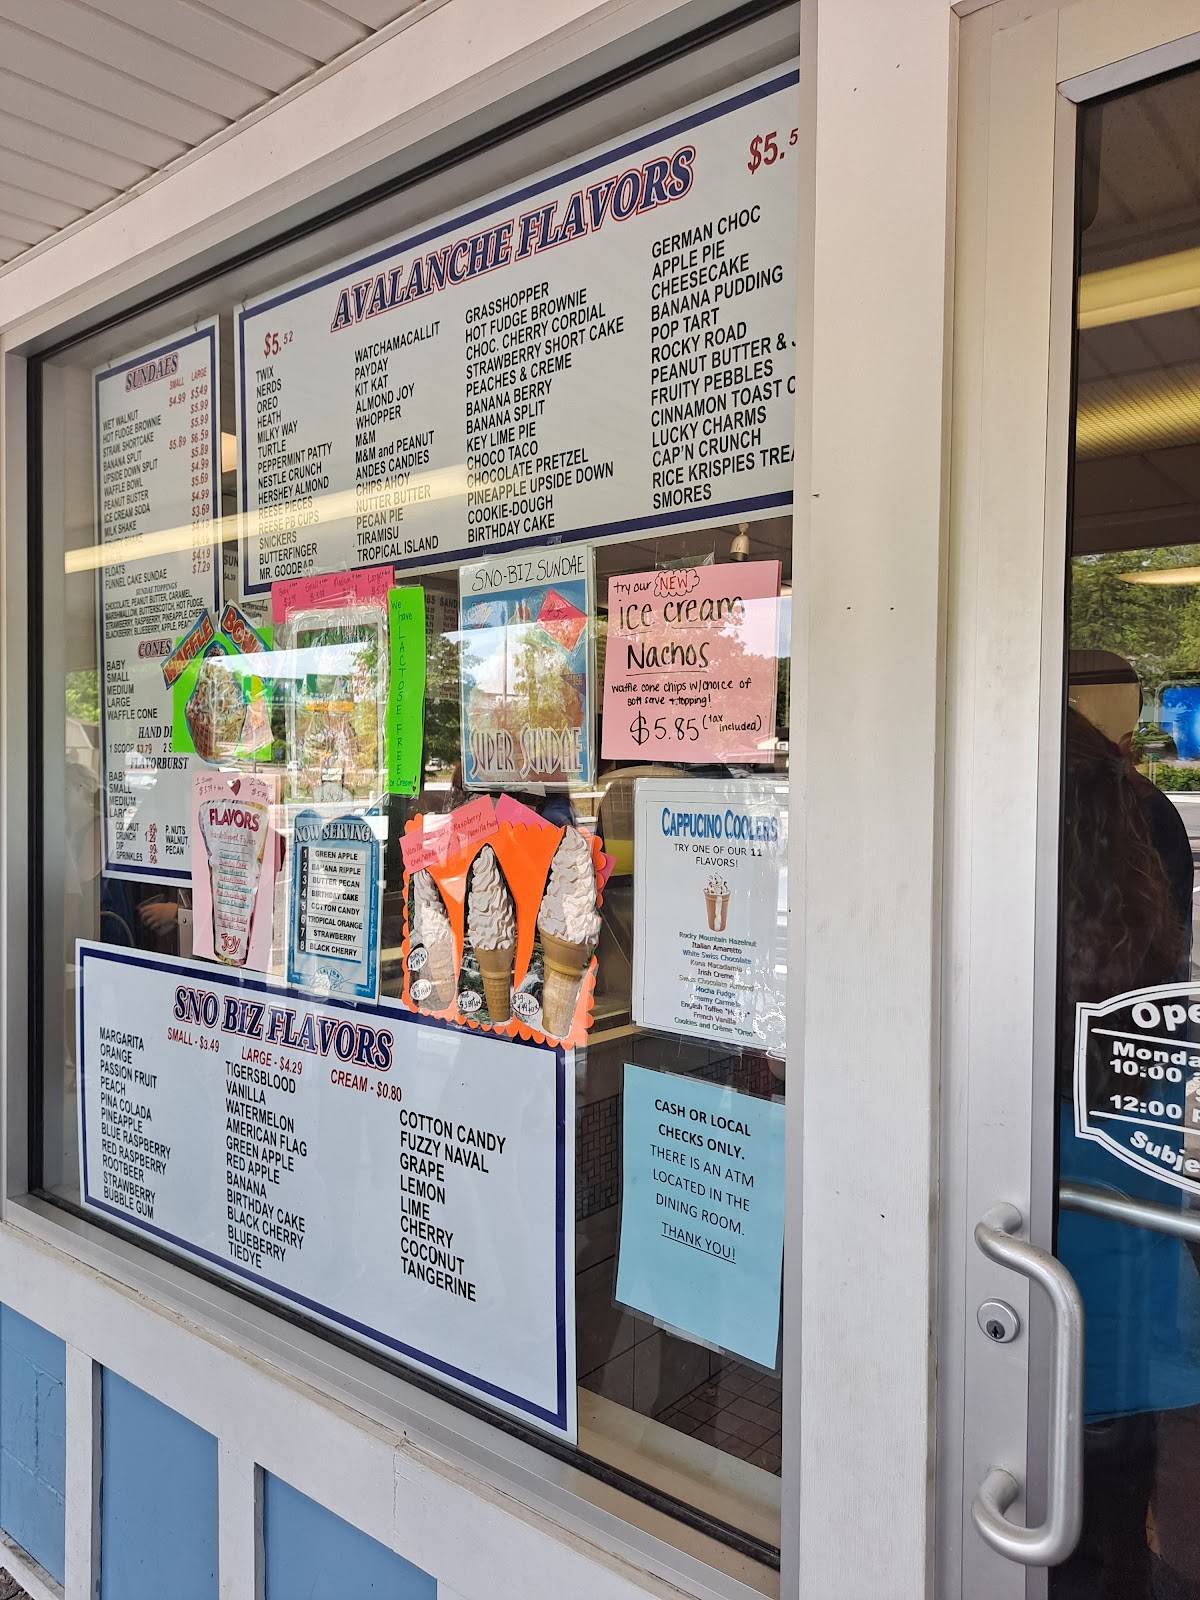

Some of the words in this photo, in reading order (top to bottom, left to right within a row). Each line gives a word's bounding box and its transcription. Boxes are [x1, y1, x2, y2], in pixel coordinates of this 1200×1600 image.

[330, 219, 515, 332] AVALANCHE
[514, 145, 696, 262] FLAVORS
[652, 222, 712, 258] GERMAN
[718, 205, 760, 235] CHOC
[652, 249, 698, 280] APPLE
[703, 239, 725, 263] PIE
[651, 253, 749, 300] CHEESECAKE
[466, 282, 549, 324] GRASSHOPPER
[651, 289, 710, 322] BANANA
[715, 265, 783, 302] PUDDING
[355, 321, 440, 363] WATCHAMACALLIT
[652, 334, 700, 364] ROCKY
[705, 322, 746, 349] ROAD
[126, 352, 178, 392] SUNDAES
[255, 365, 274, 383] TWIX
[355, 357, 388, 380] PAYDAY
[466, 369, 516, 398] PEACHES
[520, 366, 527, 382] &
[531, 352, 572, 378] CREME
[652, 378, 700, 406] FRUITY
[704, 359, 773, 392] PEBBLES
[256, 378, 282, 398] NERDS
[355, 380, 368, 397] KIT
[371, 374, 389, 392] KAT
[356, 390, 394, 414] ALMOND
[396, 383, 414, 401] JOY
[256, 395, 278, 414] OREO
[356, 405, 401, 430] WHOPPER
[257, 410, 282, 429] HEATH
[652, 421, 698, 448] LUCKY
[703, 406, 766, 436] CHARMS
[257, 439, 286, 458] TURTLE
[355, 429, 376, 448] M&M
[698, 428, 761, 458] CRUNCH
[468, 480, 526, 506] PINEAPPLE
[530, 470, 572, 493] UPSIDE
[576, 462, 613, 484] DOWN
[653, 483, 711, 509] SMORES
[468, 494, 553, 524] COOKIE-DOUGH
[259, 530, 297, 550] SNICKERS
[357, 526, 399, 546] TIRAMISU
[468, 520, 520, 543] BIRTHDAY
[524, 513, 555, 533] CAKE
[259, 542, 318, 565] BUTTERFINGER
[472, 562, 533, 592] SNO-BIZ
[536, 556, 585, 582] SUNDAE
[614, 584, 630, 595] try
[634, 582, 651, 591] our
[659, 576, 688, 590] NEW
[619, 599, 655, 630] ice
[663, 596, 745, 623] cream
[138, 638, 171, 658] CONES
[627, 642, 710, 669] Nachos
[106, 660, 126, 671] BABY
[107, 671, 129, 683] SMALL
[106, 684, 134, 696] MEDIUM
[664, 680, 686, 695] chips
[739, 678, 752, 689] of
[107, 696, 130, 708] LARGE
[107, 710, 135, 720] WAFFLE
[136, 708, 157, 719] CONE
[629, 710, 700, 746] $5.85
[470, 726, 516, 778] SUPER
[520, 724, 583, 778] SUNDAE
[209, 808, 260, 832] FLAVORS
[662, 808, 722, 839] CAPPUCINO
[315, 850, 336, 859] GREEN
[337, 852, 358, 861] APPLE
[674, 843, 689, 852] TRY
[692, 845, 710, 854] ONE
[713, 846, 724, 854] OF
[728, 847, 747, 856] OUR
[750, 848, 762, 856] 11
[696, 857, 738, 868] FLAVORS!
[342, 892, 359, 902] CAKE
[313, 930, 356, 943] STRAWBERRY
[692, 942, 711, 950] Italian
[683, 949, 700, 958] White
[721, 955, 752, 964] Chocolate
[100, 1027, 144, 1051] MARGARITA
[168, 1028, 193, 1046] SMALL
[200, 1036, 220, 1052] $3.49
[174, 986, 219, 1028] SNO
[221, 996, 265, 1039] BIZ
[266, 1005, 393, 1071] FLAVORS
[100, 1043, 132, 1064] ORANGE
[241, 1047, 272, 1067] LARGE
[279, 1056, 302, 1075] $4.29
[225, 1060, 295, 1094] TIGERSBLOOD
[330, 1069, 368, 1092] CREAM
[377, 1082, 402, 1102] $0.80
[1110, 1059, 1182, 1083] 10:00
[100, 1076, 126, 1096] PEACH
[226, 1080, 266, 1105] VANILLA
[226, 1098, 294, 1134] WATERMELON
[655, 1099, 685, 1118] CASH
[689, 1109, 707, 1124] OR
[711, 1114, 751, 1136] LOCAL
[1110, 1094, 1182, 1119] 12:00
[400, 1109, 452, 1140] COTTON
[457, 1125, 506, 1154] CANDY
[658, 1124, 703, 1147] CHECKS
[707, 1138, 744, 1160] ONLY.
[401, 1130, 441, 1158] FUZZY
[445, 1143, 488, 1173] NAVAL
[1130, 1130, 1200, 1172] Subje
[102, 1154, 144, 1183] ROOTBEER
[400, 1153, 444, 1182] GRAPE
[651, 1144, 686, 1166] THERE
[690, 1157, 700, 1170] IS
[703, 1162, 721, 1177] AN
[725, 1168, 754, 1188] ATM
[227, 1170, 267, 1199] BANANA
[401, 1174, 445, 1204] LEMON
[653, 1169, 706, 1196] LOCATED
[710, 1188, 722, 1202] IN
[726, 1192, 749, 1212] THE
[227, 1188, 274, 1219] BIRTHDAY
[277, 1208, 305, 1233] CAKE
[401, 1196, 430, 1221] LIME
[656, 1193, 697, 1218] DINING
[702, 1209, 744, 1236] ROOM.
[401, 1215, 453, 1249] CHERRY
[662, 1222, 701, 1248] THANK
[705, 1238, 735, 1258] YOU!
[228, 1241, 262, 1269] TIEDYE
[401, 1237, 464, 1275] COCONUT
[401, 1256, 476, 1302] TANGERINE
